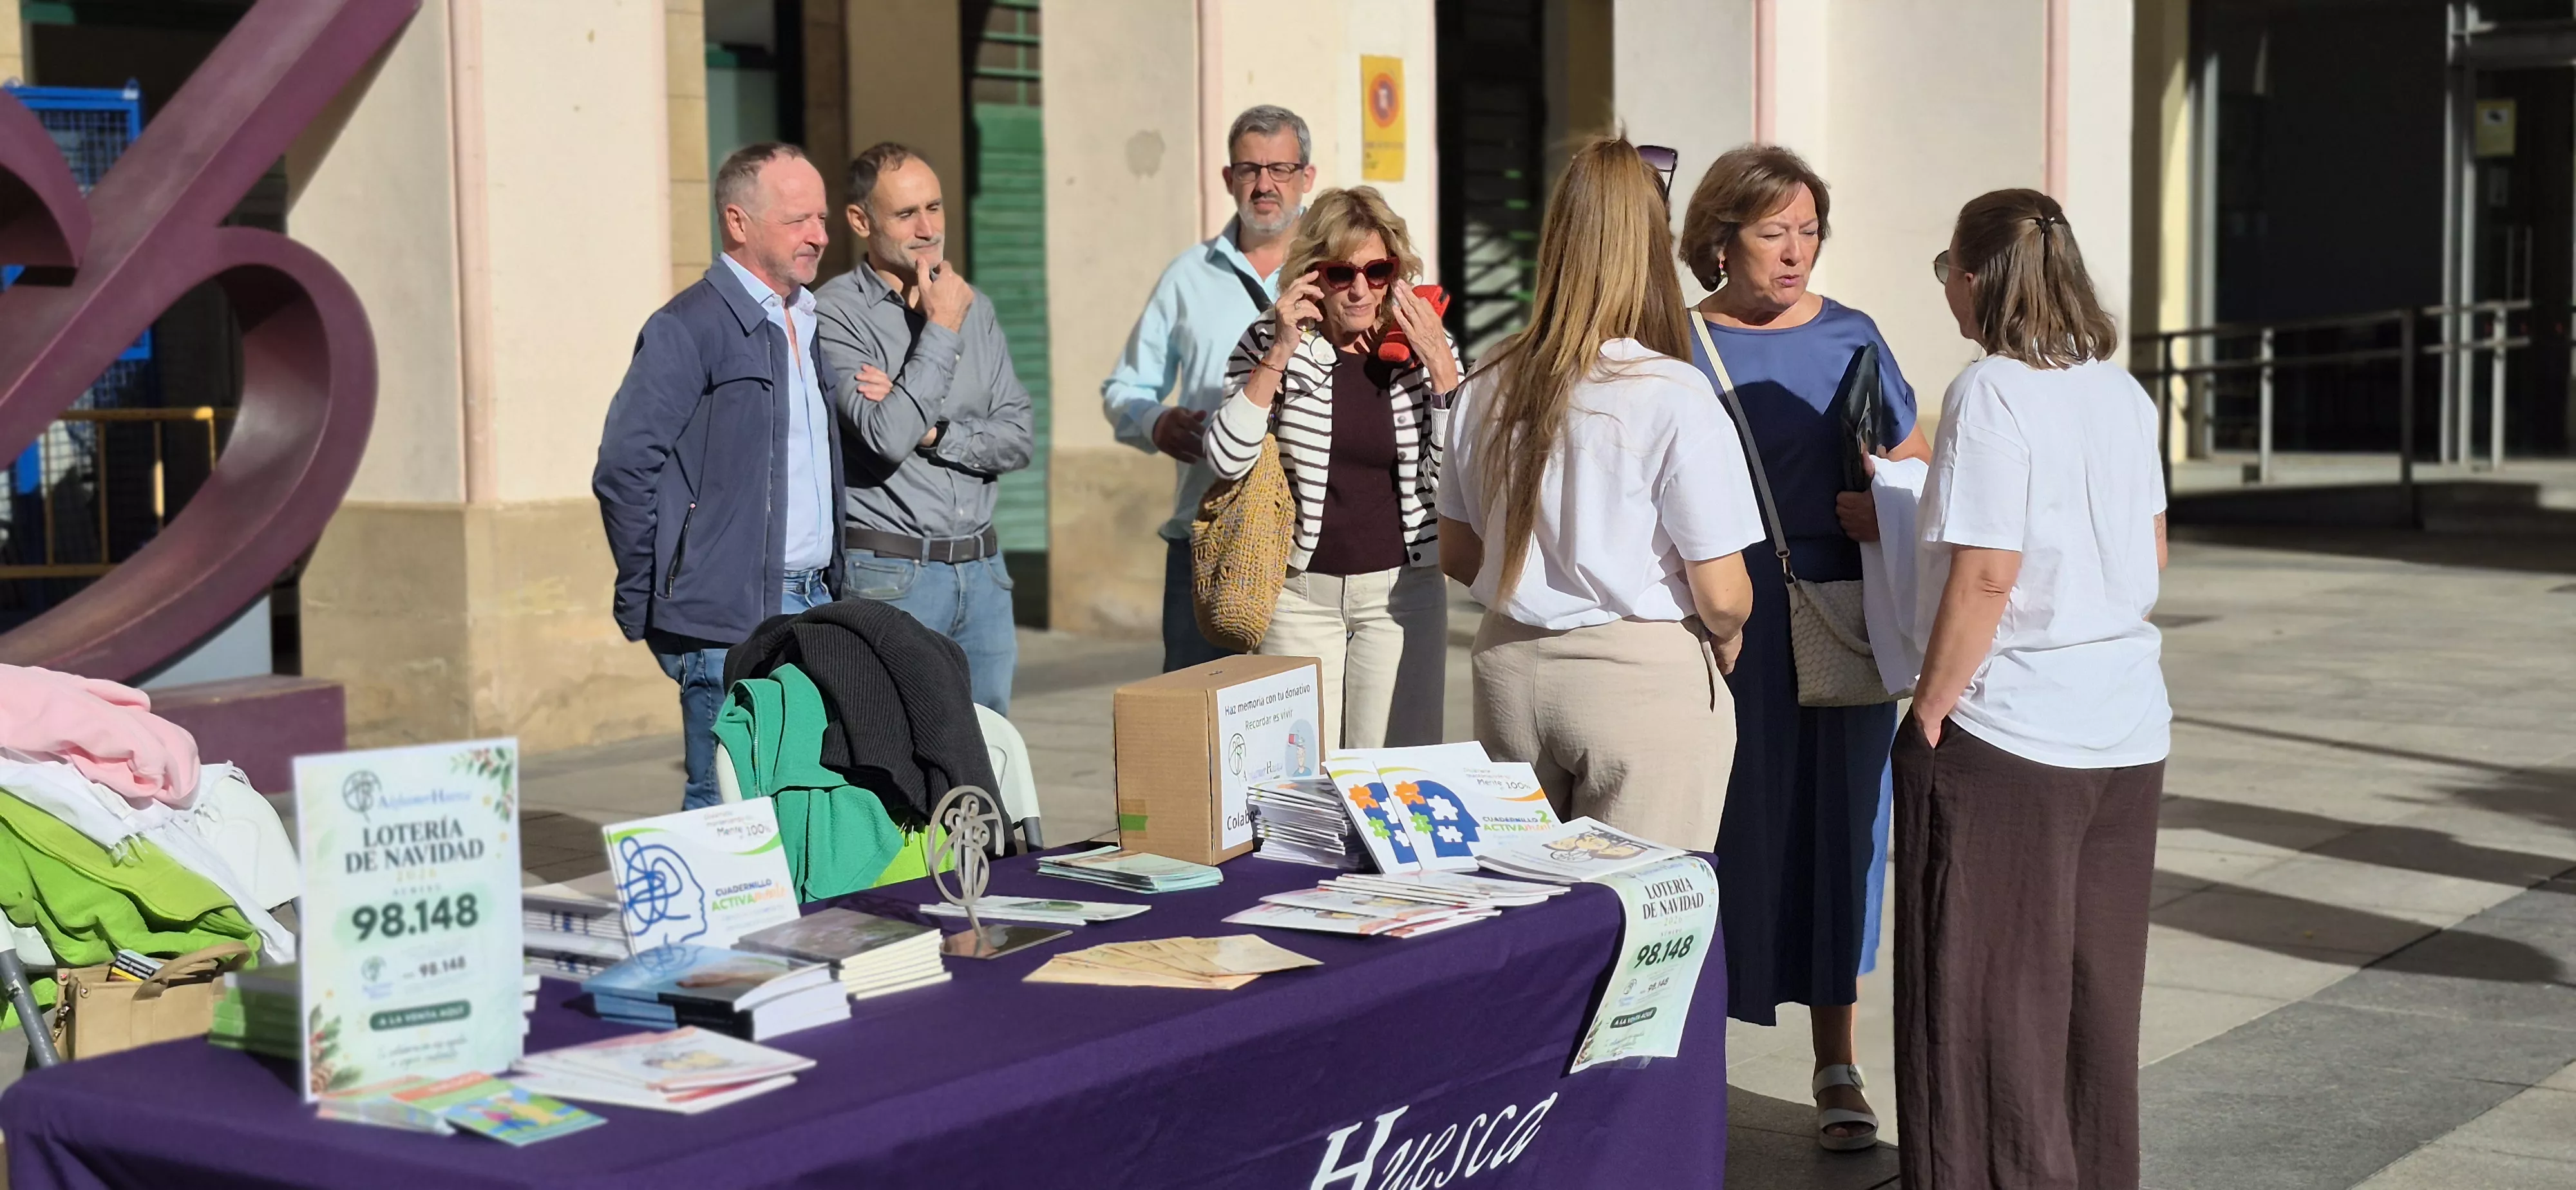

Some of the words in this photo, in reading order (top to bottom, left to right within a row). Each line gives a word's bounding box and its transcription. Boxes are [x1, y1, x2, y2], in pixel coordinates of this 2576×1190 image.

[1225, 704, 1236, 716] Haz
[1238, 696, 1265, 713] memoria
[1265, 694, 1276, 704] con
[1278, 691, 1284, 701] tu
[1285, 683, 1311, 699] donativo
[1245, 712, 1271, 731] Recordar
[1273, 712, 1280, 722] es
[1280, 708, 1293, 721] vivir
[1477, 778, 1502, 786] Mente
[363, 813, 464, 849] LOTERÍA
[1534, 809, 1553, 824] 2
[345, 851, 379, 874] DE
[384, 838, 485, 870] NAVIDAD
[715, 878, 772, 897] CUADERNILLO
[1644, 874, 1694, 900] LOTERÍA
[352, 891, 479, 943] 98.148
[1642, 902, 1658, 920] DE
[1660, 892, 1704, 916] NAVIDAD
[1633, 934, 1694, 969] 98.148
[1309, 1091, 1558, 1190] Huesca
